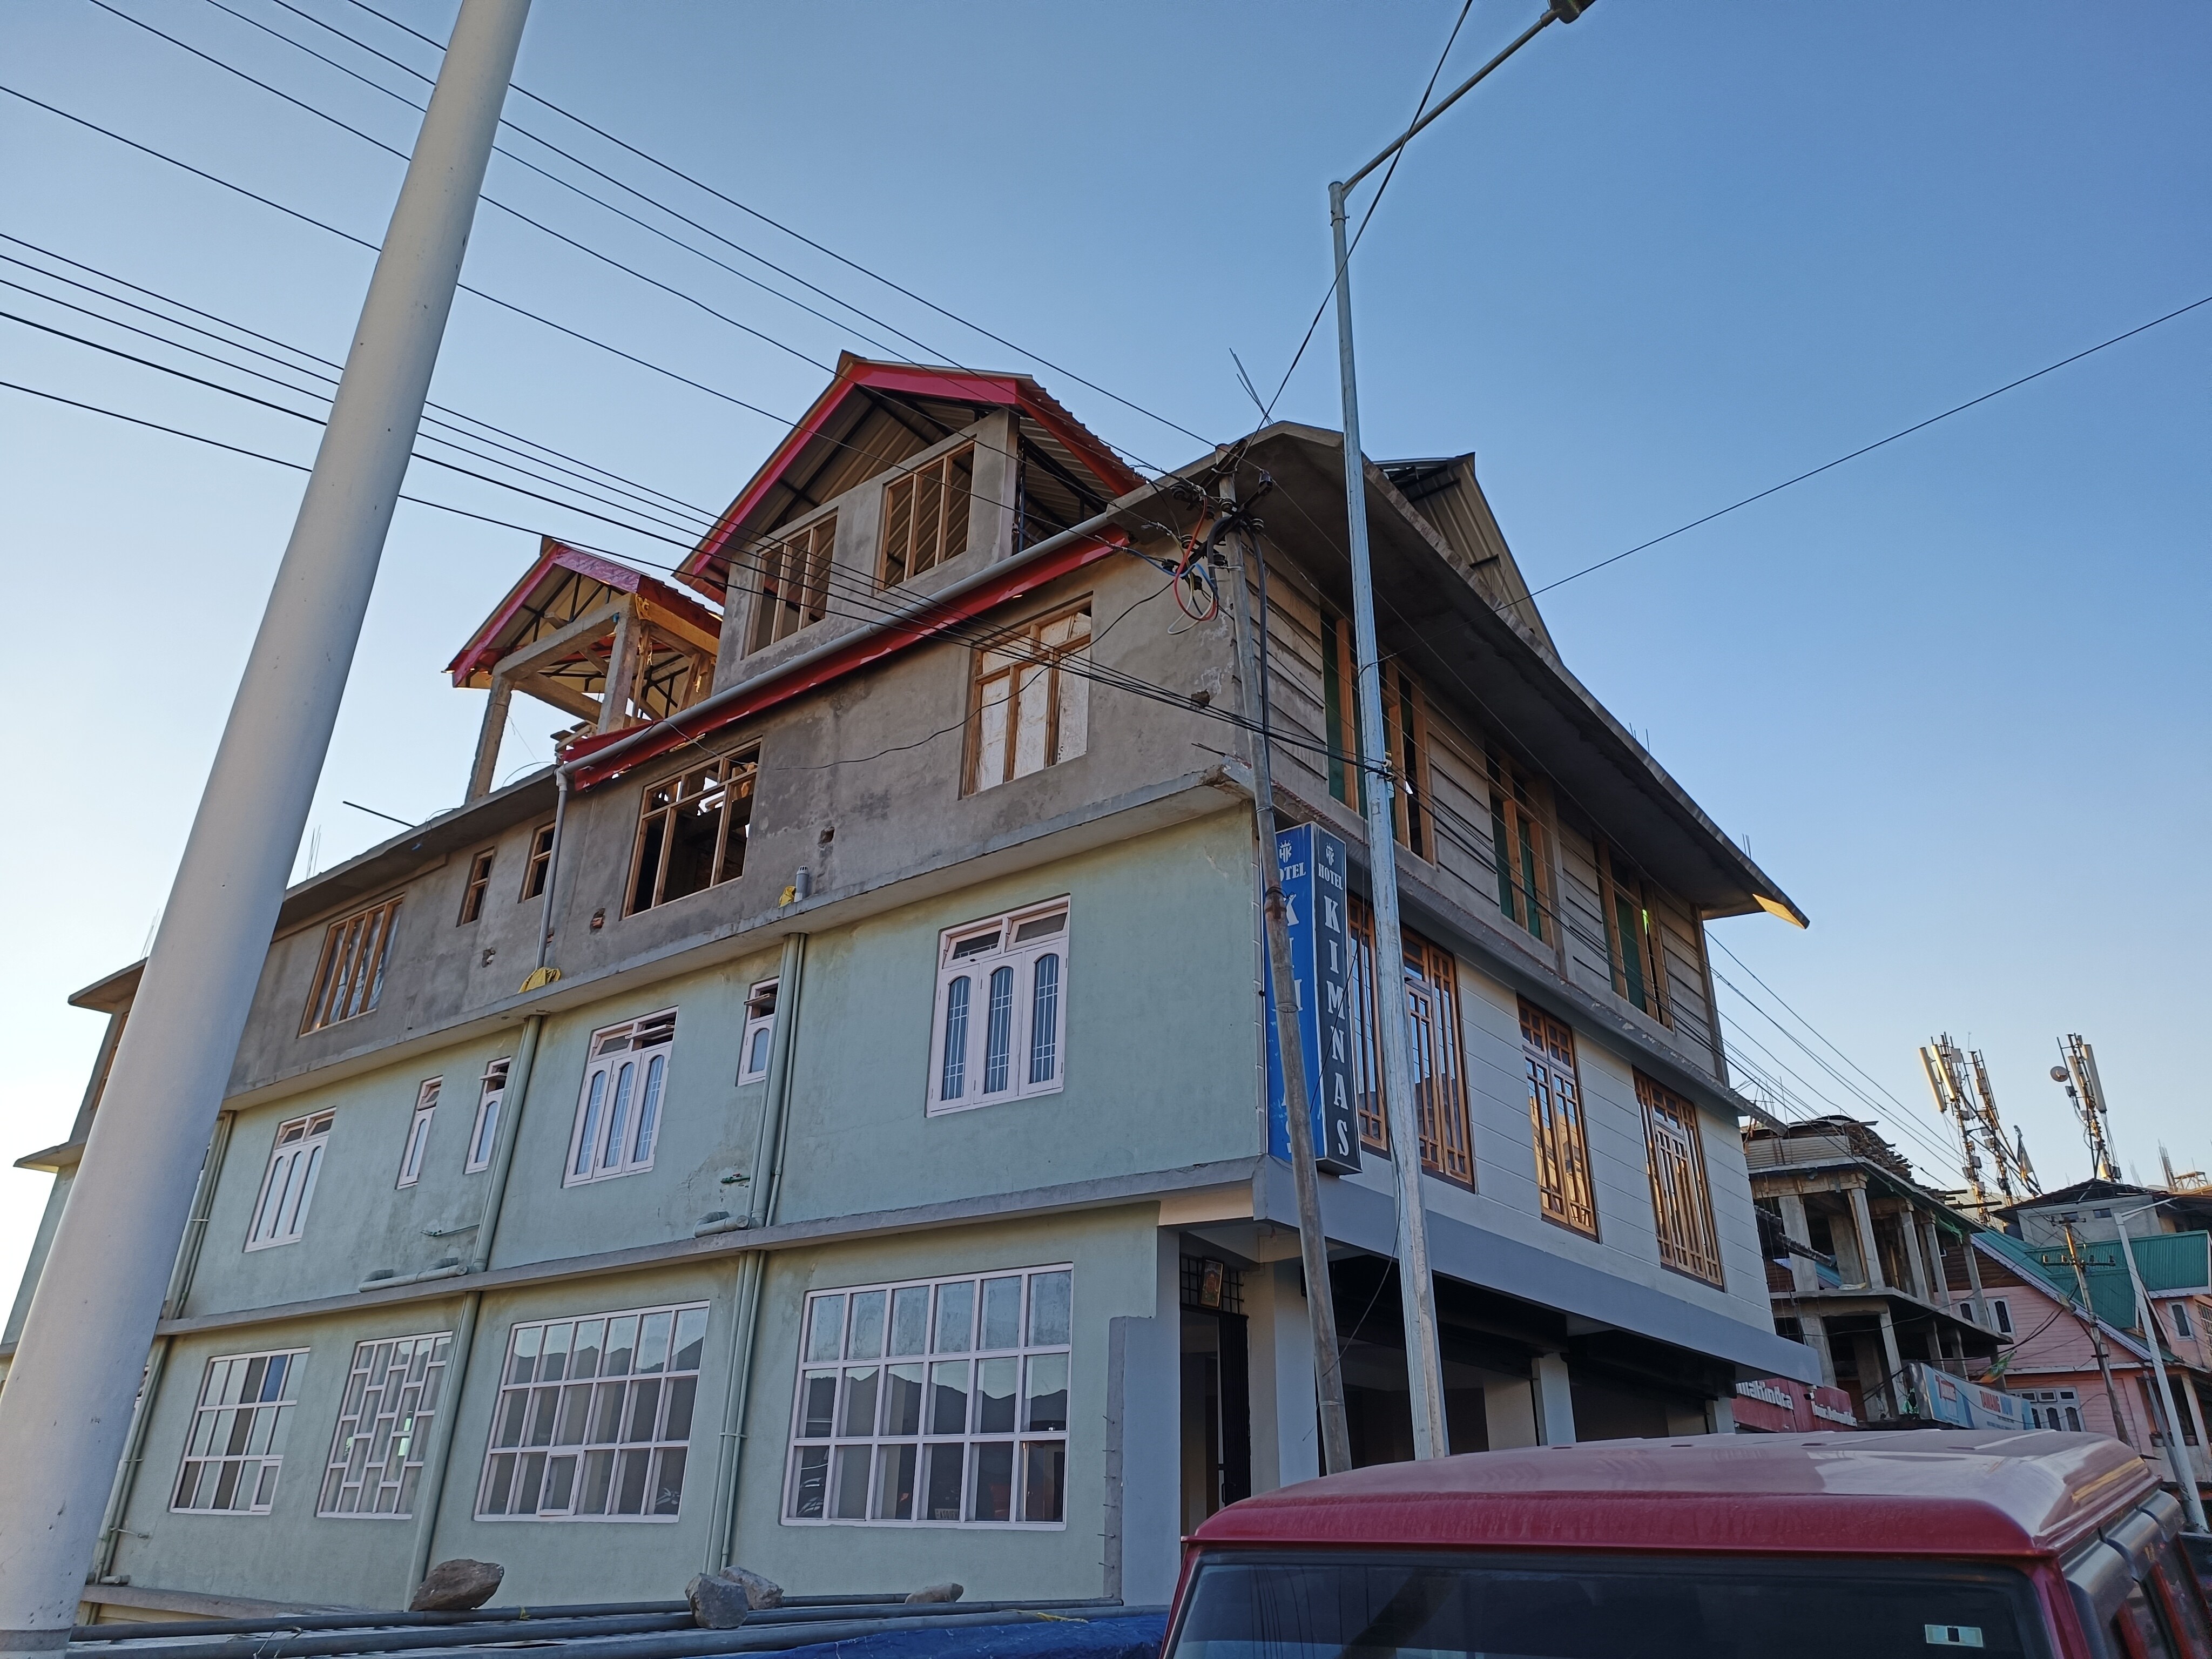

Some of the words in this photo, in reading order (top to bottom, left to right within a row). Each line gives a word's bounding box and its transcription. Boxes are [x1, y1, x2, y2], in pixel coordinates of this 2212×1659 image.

[1279, 862, 1306, 882] OTEL
[1318, 862, 1343, 891] HOTEL
[1324, 895, 1349, 1156] KIMNAS
[1736, 1380, 1793, 1410] mahindra
